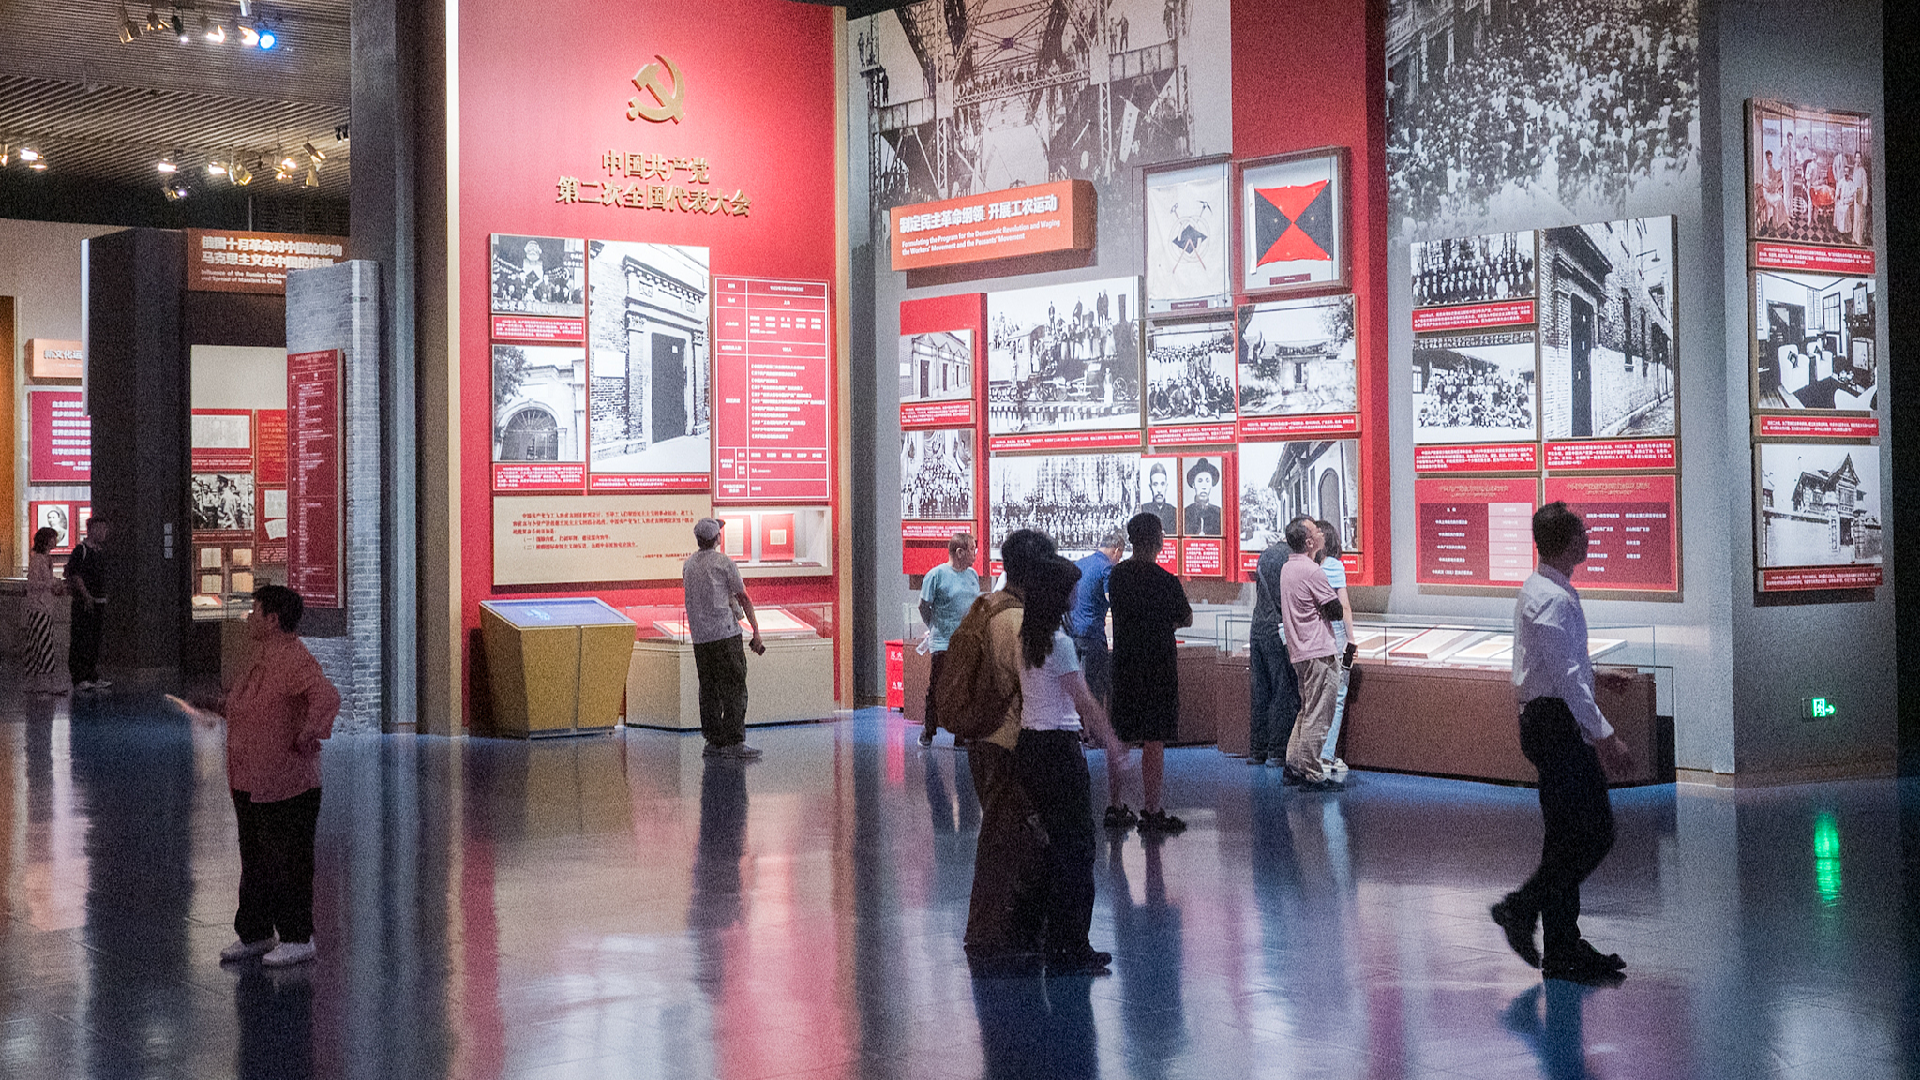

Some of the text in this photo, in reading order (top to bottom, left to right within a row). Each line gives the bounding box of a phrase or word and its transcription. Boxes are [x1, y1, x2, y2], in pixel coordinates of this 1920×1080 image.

[602, 149, 710, 183] 中国共产党
[556, 175, 751, 217] 第二次全国代表大会
[899, 193, 1059, 234] 制定民主革命纲领 开展工农运动
[938, 234, 958, 243] Program
[975, 226, 1002, 237] Democratic
[1002, 224, 1030, 234] Revolution
[1030, 221, 1040, 229] and
[1040, 219, 1060, 229] Waging
[956, 240, 967, 248] and
[202, 235, 343, 257] 俄国十月革命对中国的影响
